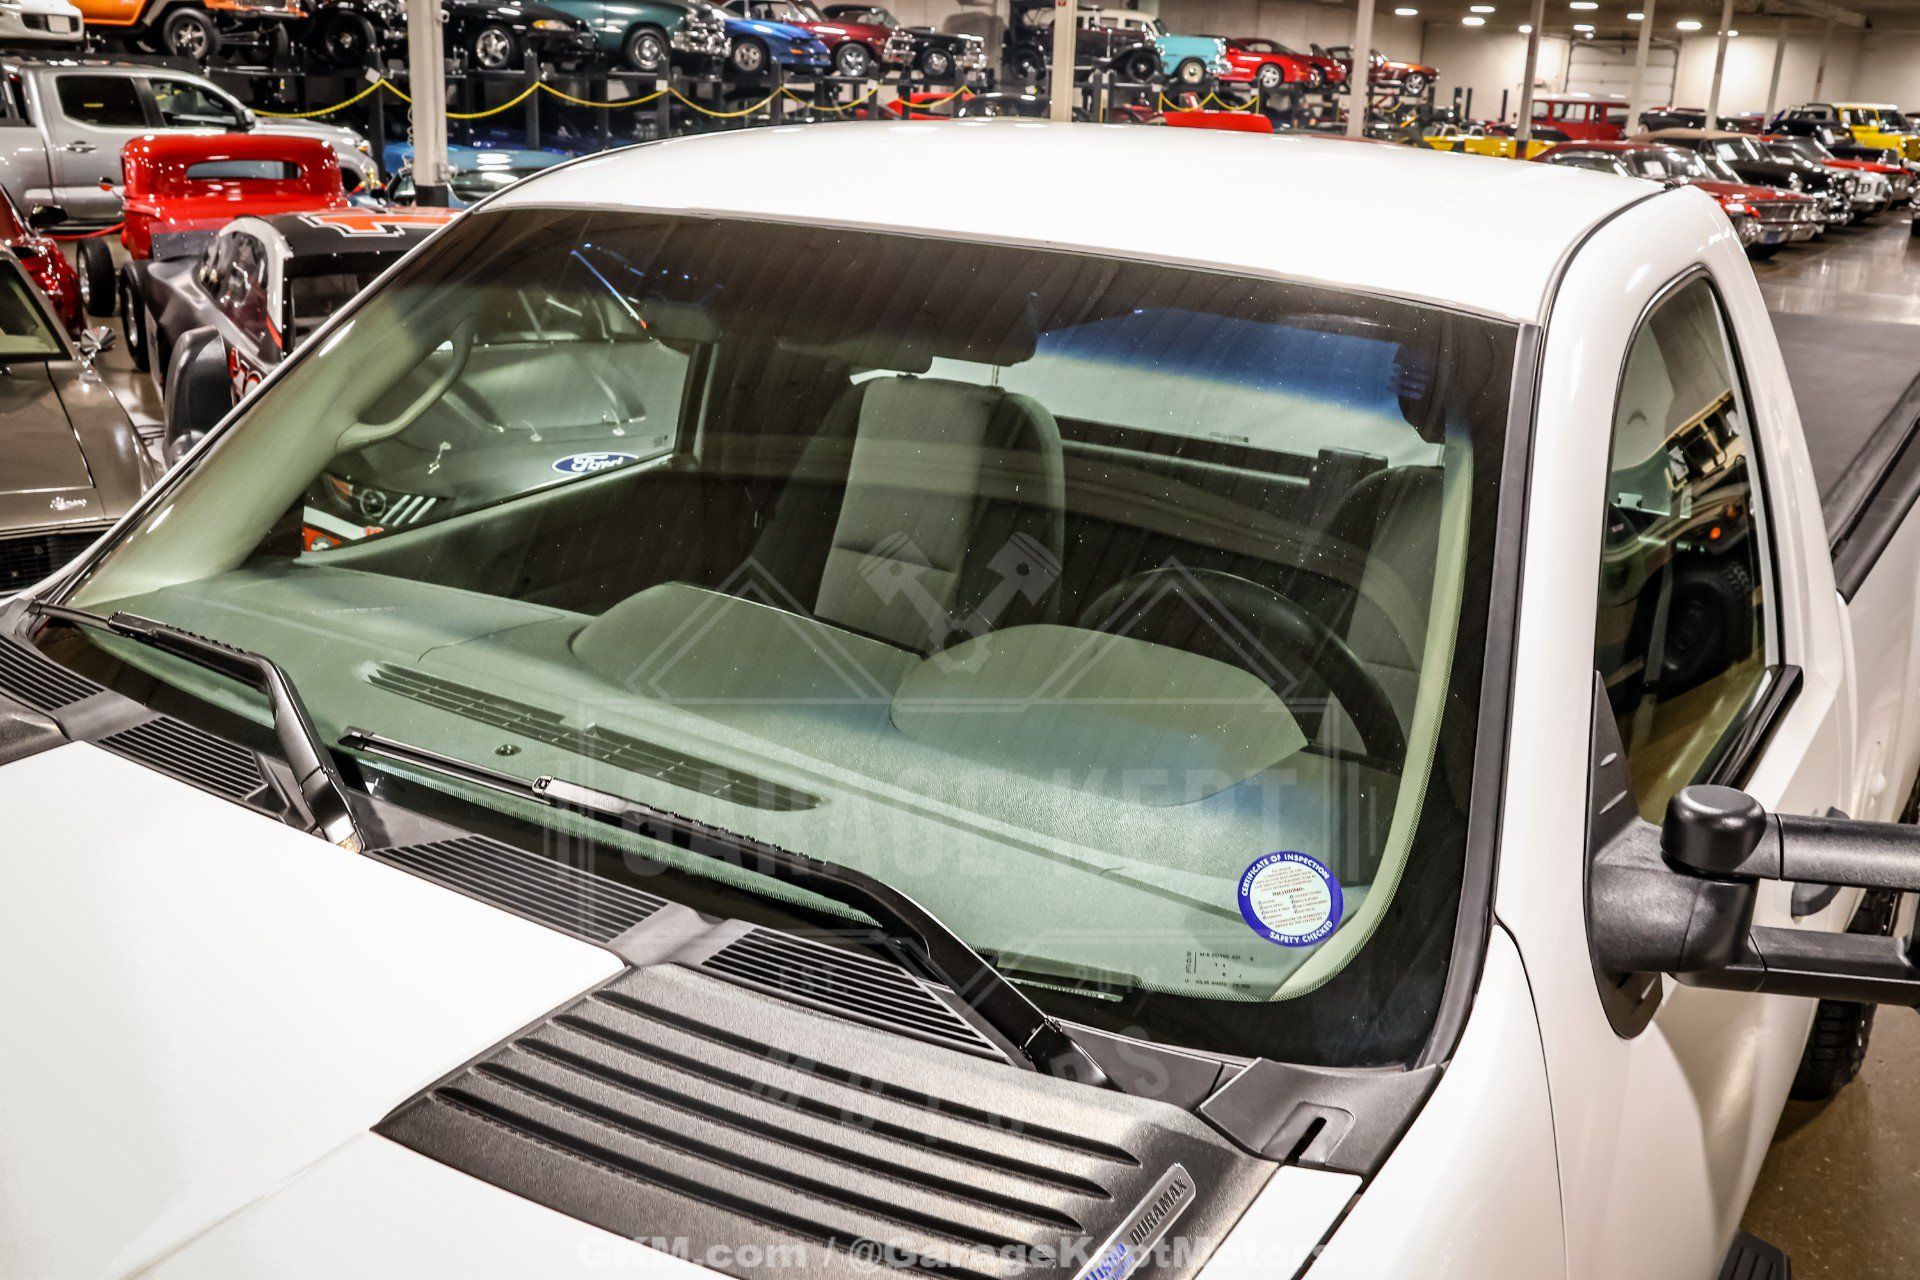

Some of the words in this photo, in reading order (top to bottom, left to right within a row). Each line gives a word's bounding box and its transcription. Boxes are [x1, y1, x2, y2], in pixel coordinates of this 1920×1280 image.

[1241, 858, 1270, 897] CERTIFICATE
[1270, 853, 1281, 863] OF
[1284, 853, 1331, 880] INSPECTION
[1269, 931, 1300, 944] SAFETY
[1302, 920, 1334, 943] CHECKED
[1129, 1175, 1188, 1246] DURAMAX
